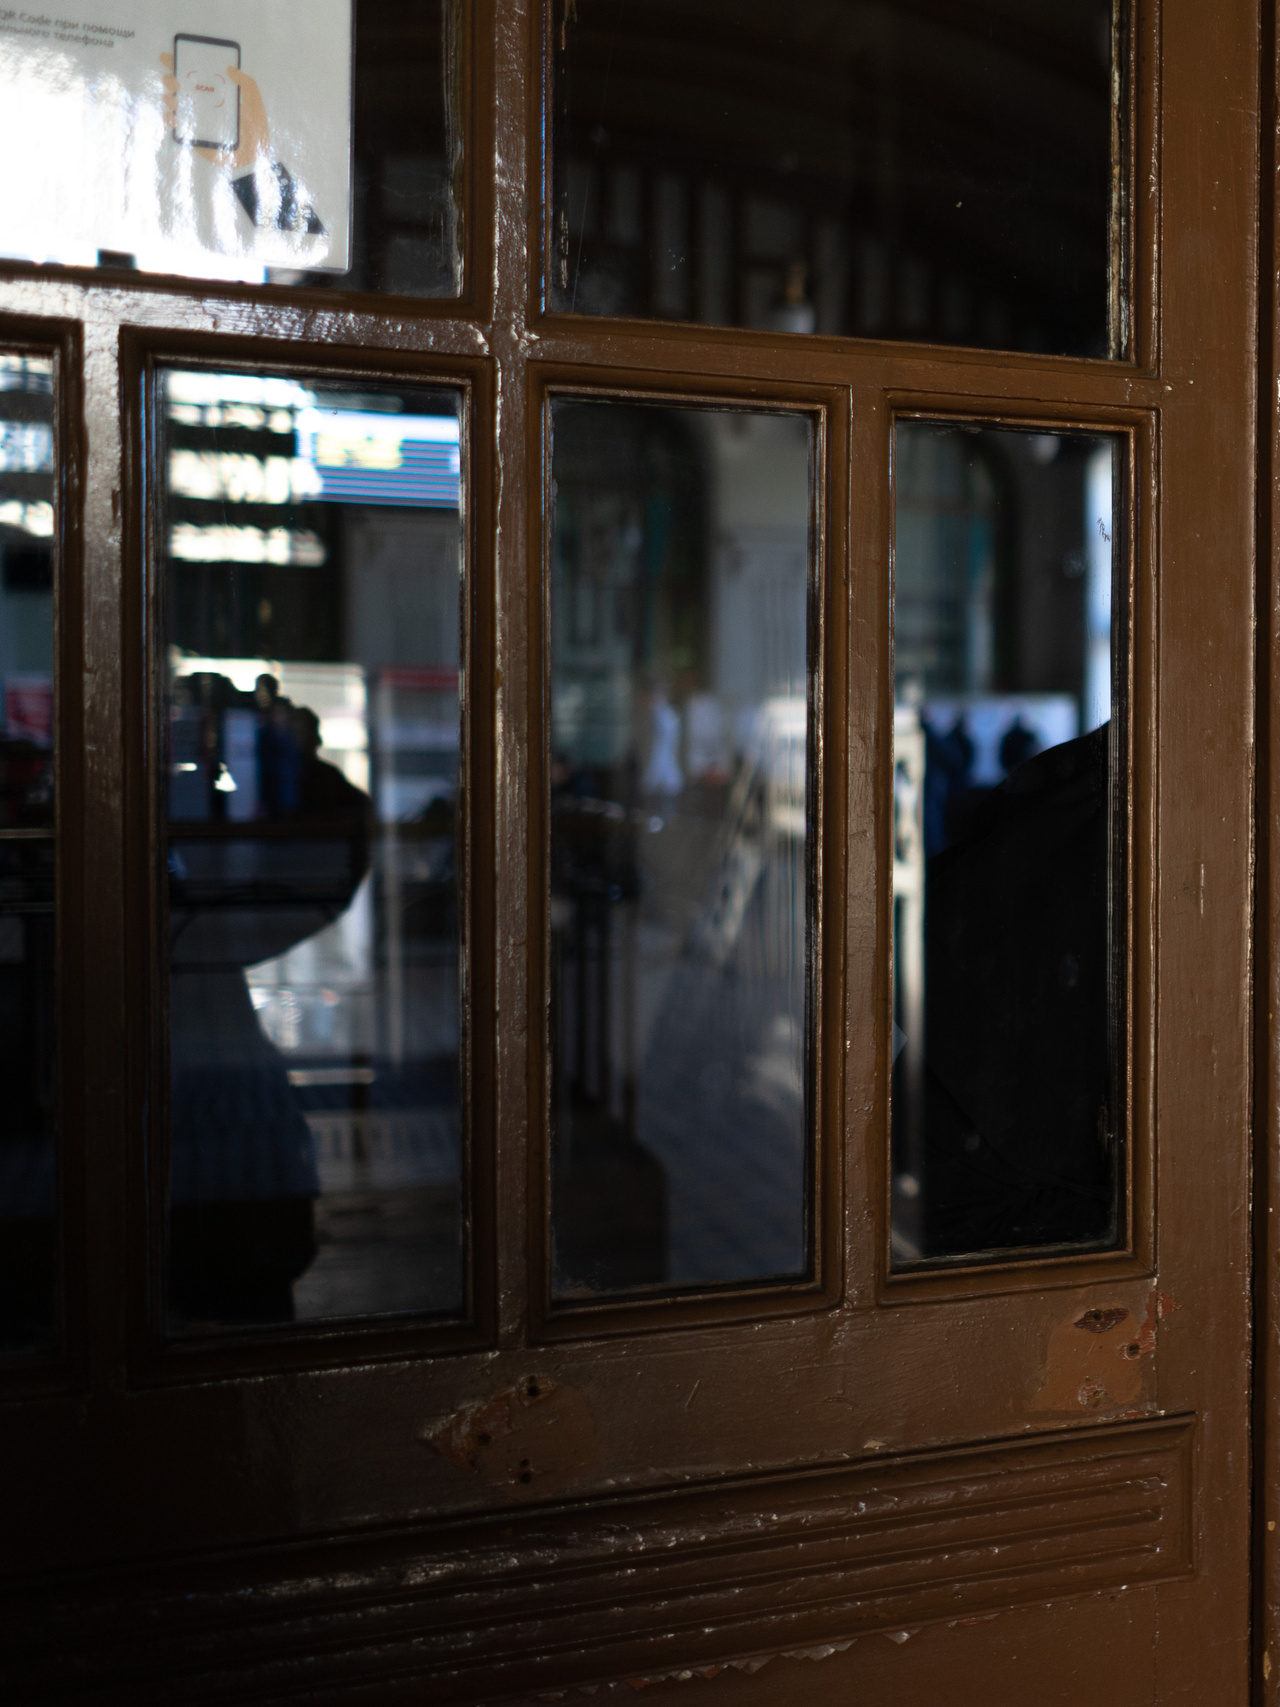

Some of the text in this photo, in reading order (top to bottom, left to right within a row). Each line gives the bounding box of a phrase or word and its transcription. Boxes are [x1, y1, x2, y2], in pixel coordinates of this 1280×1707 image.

[54, 19, 79, 30] при
[82, 23, 135, 38] помощи
[54, 32, 114, 47] телефона
[195, 84, 215, 93] SCAN
